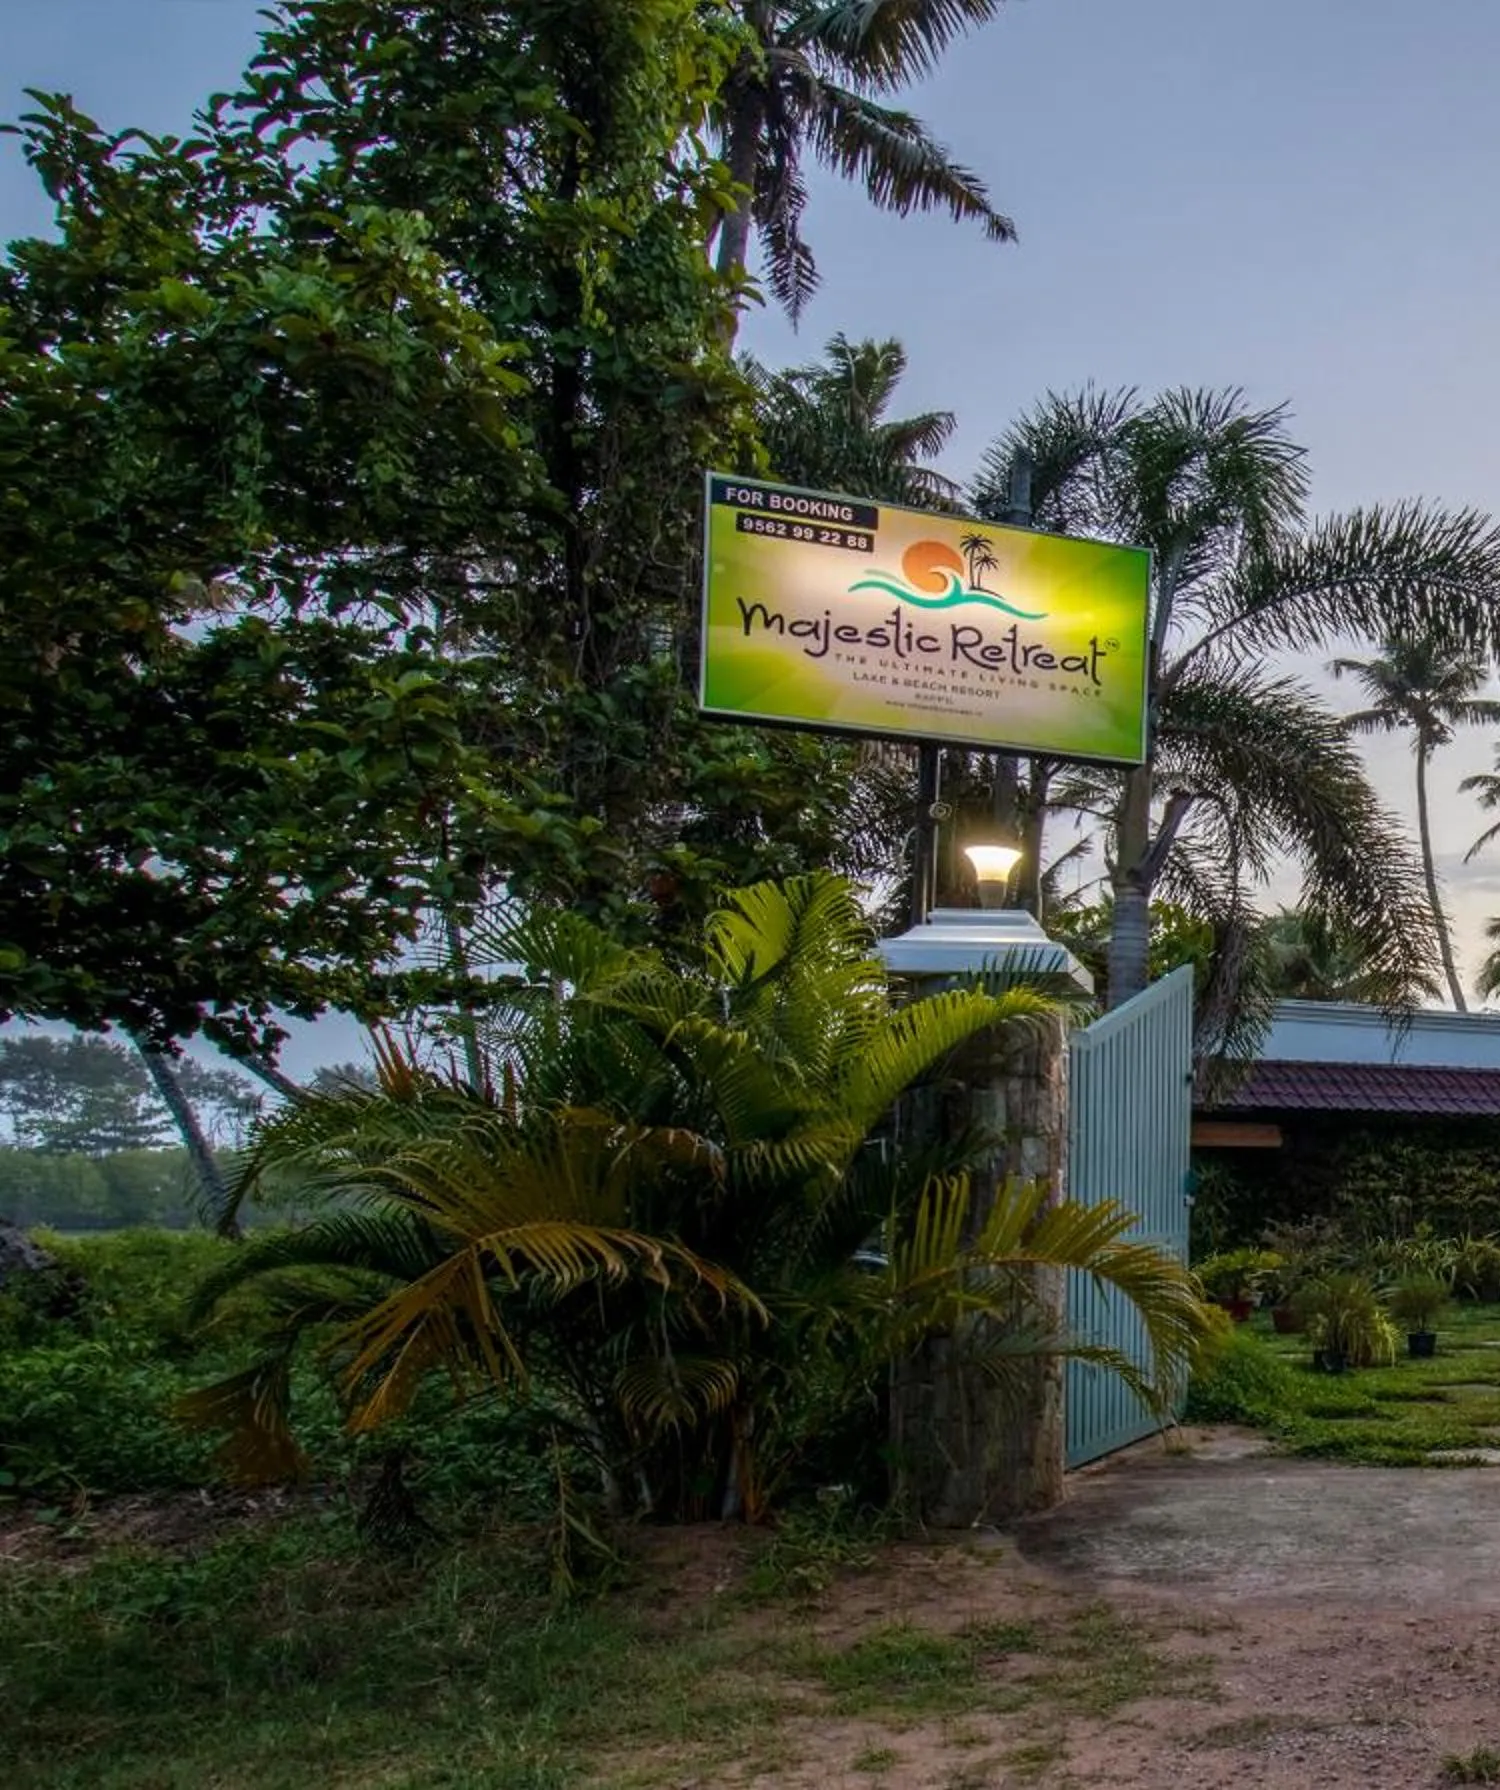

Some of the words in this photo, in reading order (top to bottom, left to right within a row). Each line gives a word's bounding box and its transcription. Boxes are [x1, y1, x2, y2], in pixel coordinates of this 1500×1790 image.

[726, 487, 764, 506] FOR
[769, 494, 854, 521] BOOKING
[743, 517, 787, 535] 9562
[793, 526, 814, 541] 99
[819, 531, 841, 545] 22
[737, 596, 942, 658] Majestic
[951, 623, 1107, 687] Retreat
[835, 653, 867, 665] THE
[879, 659, 968, 679] ULTIMATE
[979, 673, 1039, 689] LIVING
[1050, 683, 1102, 697] SPACE
[853, 671, 887, 684] LAKE
[903, 679, 947, 692] BEACH
[951, 685, 1000, 699] RESORT
